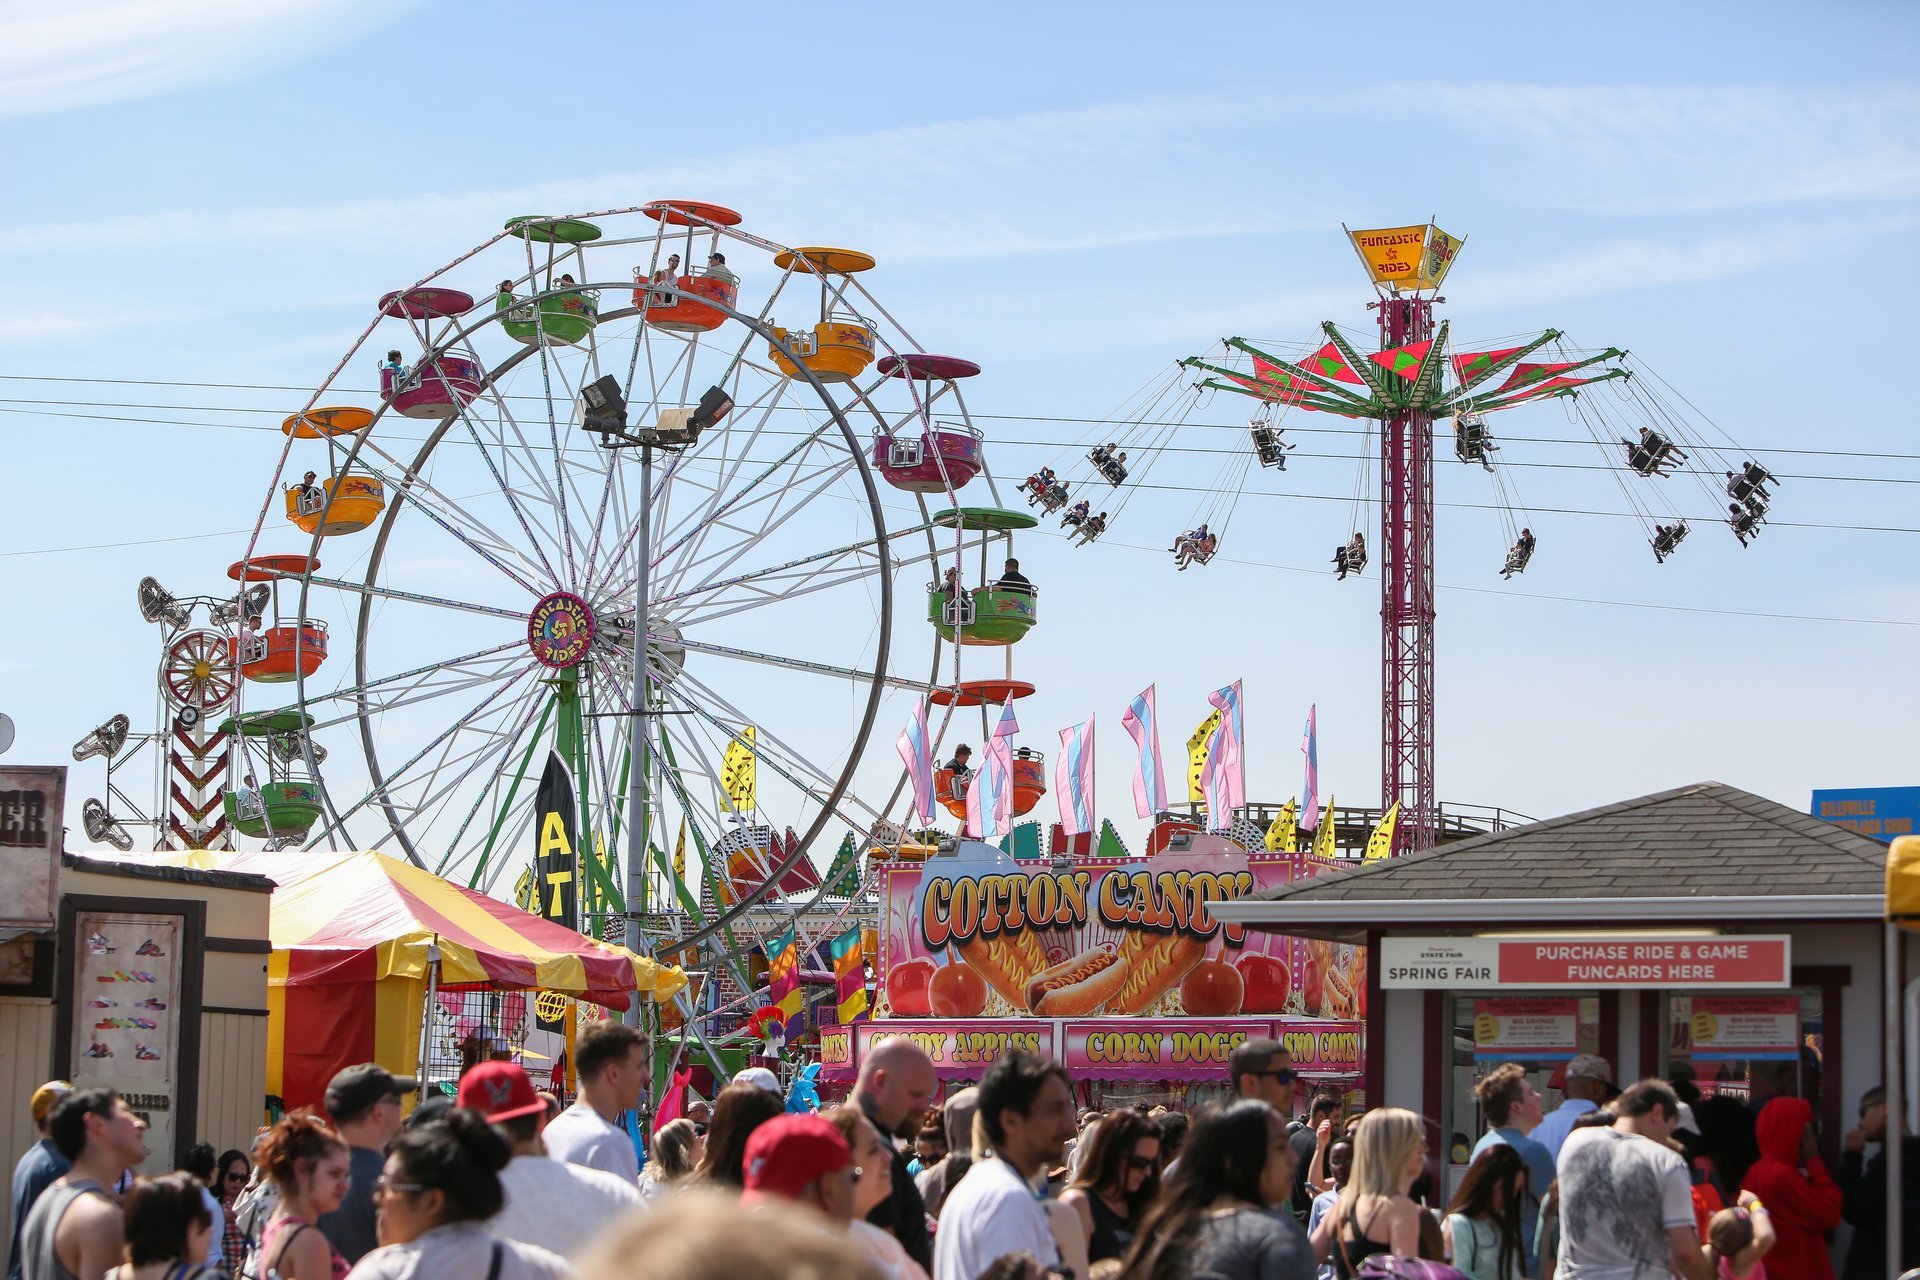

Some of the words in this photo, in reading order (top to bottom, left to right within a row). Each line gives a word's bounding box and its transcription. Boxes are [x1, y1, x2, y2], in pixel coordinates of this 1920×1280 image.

[1377, 261, 1411, 274] RIDES
[545, 640, 583, 662] RIDES
[921, 871, 1091, 950] COTTON
[1098, 870, 1254, 948] CANDY
[1535, 946, 1628, 960] PURCHASE
[1633, 946, 1675, 960] RIDE
[1679, 946, 1691, 960] &
[1697, 945, 1749, 959] GAME
[1388, 967, 1449, 980] SPRING
[1454, 967, 1491, 980] FAIR
[1567, 965, 1663, 979] FUNCARDS
[1668, 964, 1715, 979] HERE
[870, 1032, 947, 1062] CDY
[952, 1032, 1040, 1062] APPLES
[1086, 1032, 1163, 1063] CORN
[1283, 1031, 1315, 1063] SNO
